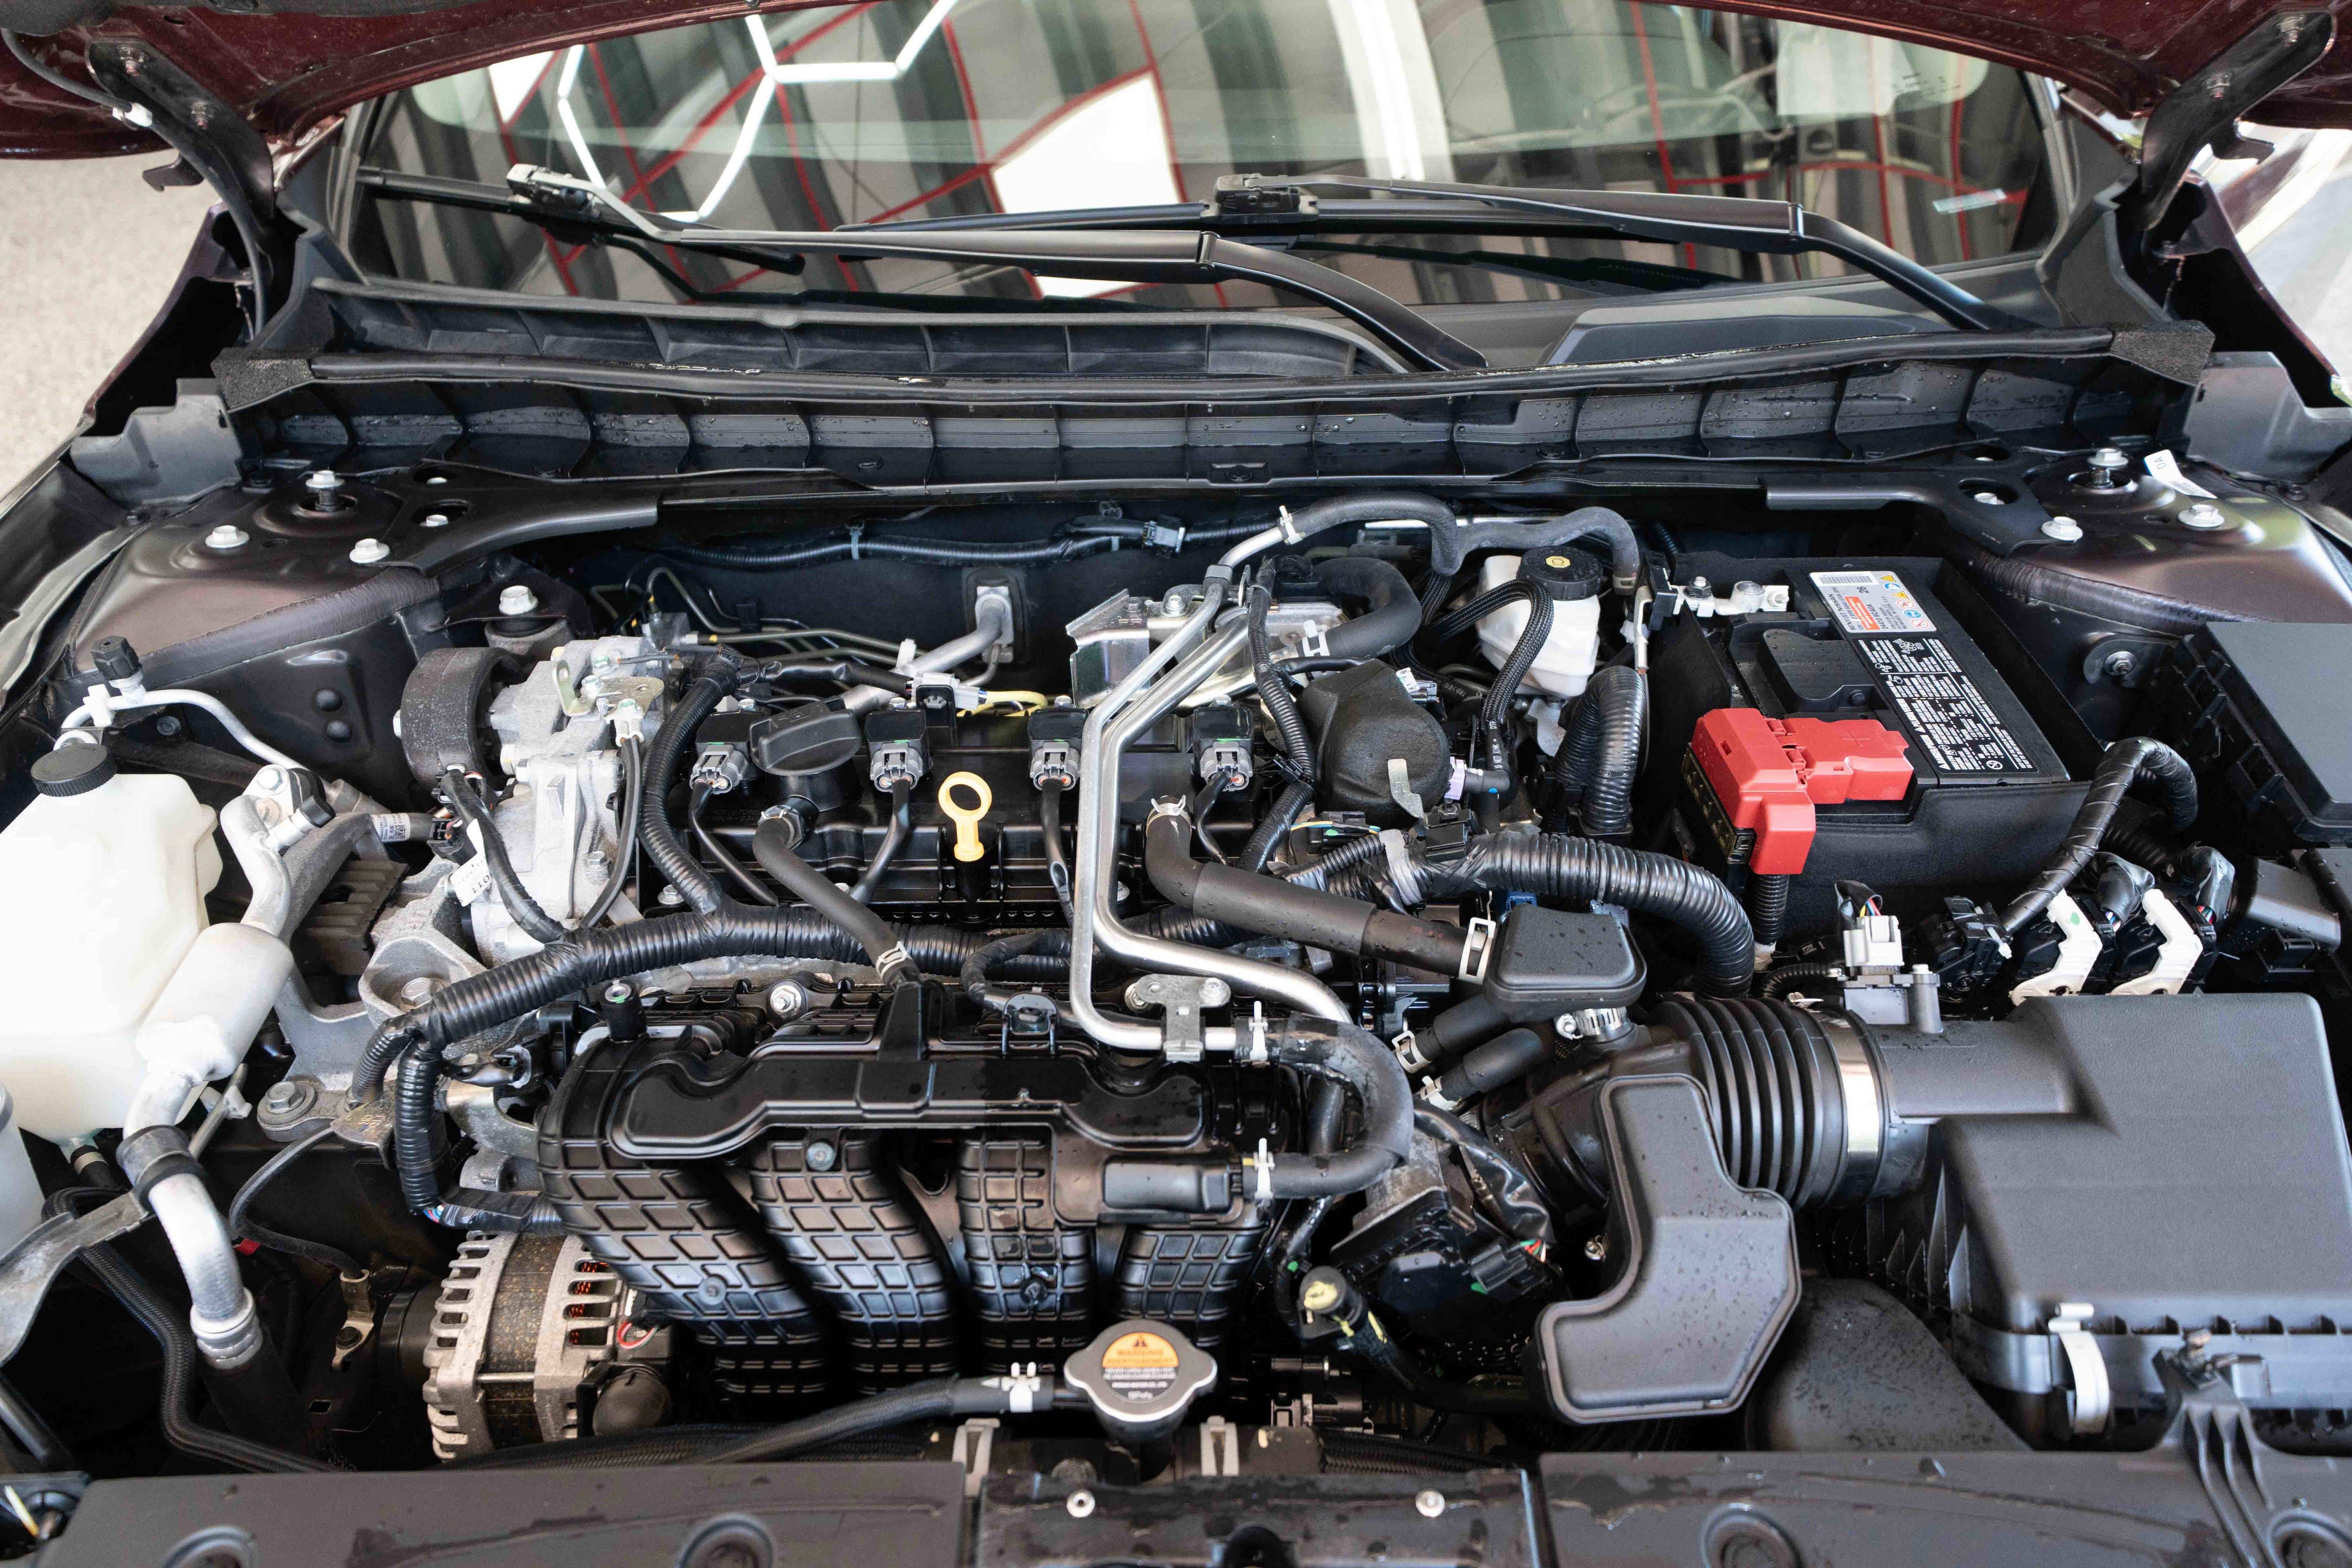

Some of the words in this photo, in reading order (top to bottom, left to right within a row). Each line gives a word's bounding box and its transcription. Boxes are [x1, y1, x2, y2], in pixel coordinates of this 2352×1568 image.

[1827, 594, 1844, 611] NISSAN
[1839, 612, 1856, 630] RENAULT
[1492, 744, 1501, 754] KINK
[1919, 734, 1947, 764] DANGER/POISON
